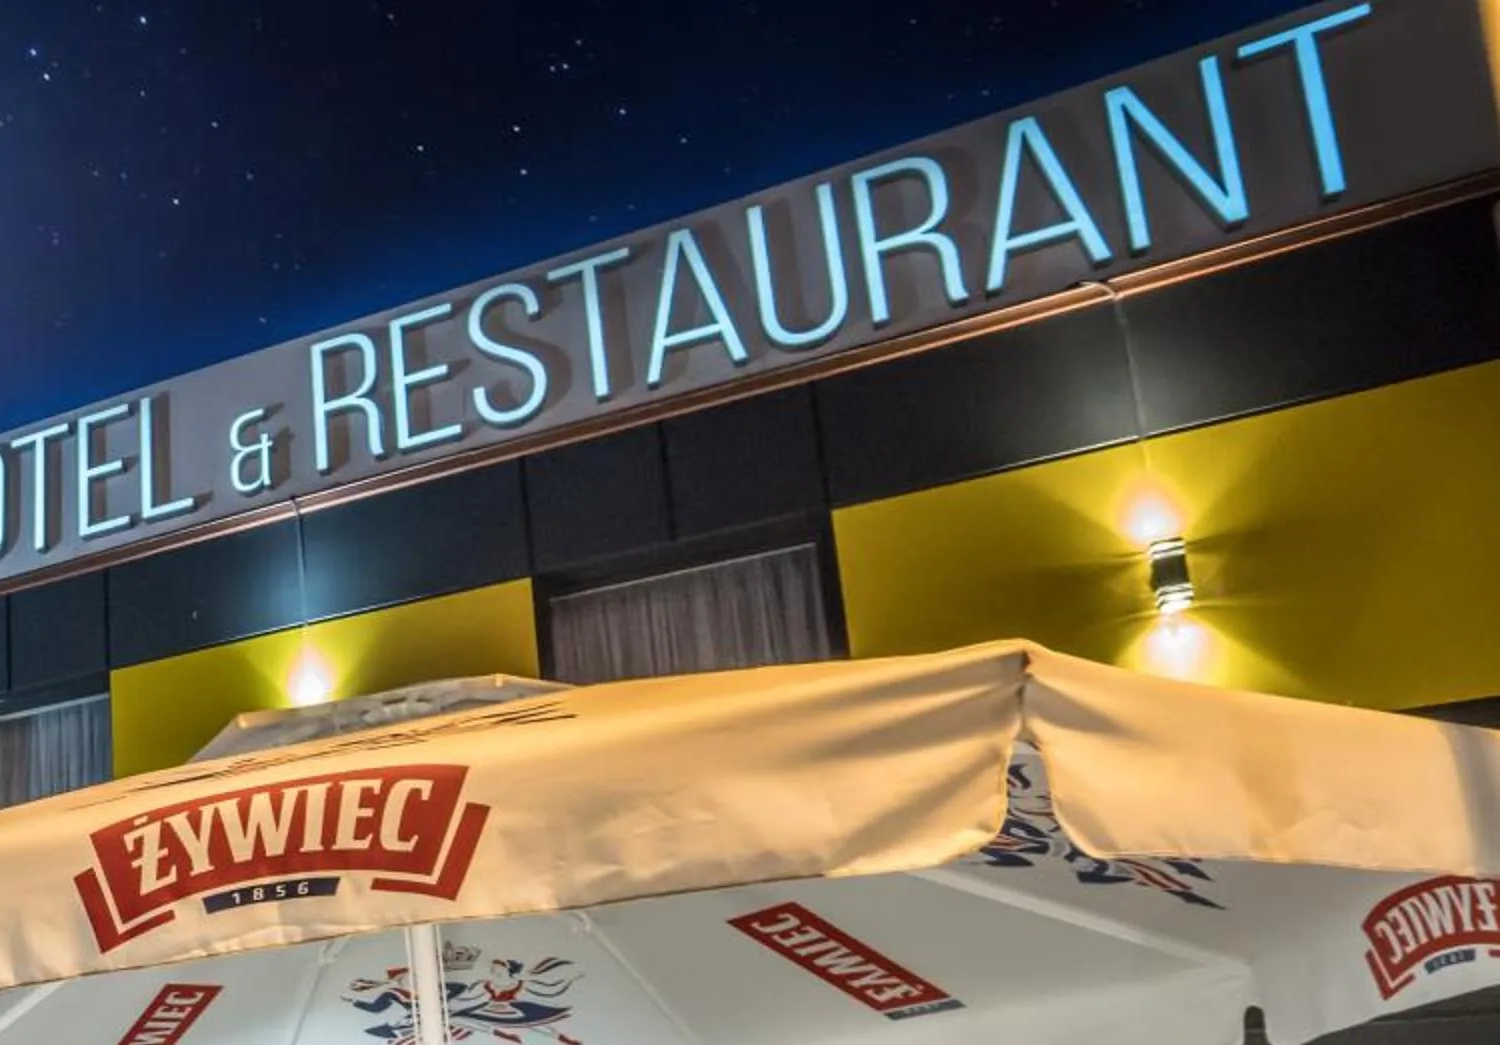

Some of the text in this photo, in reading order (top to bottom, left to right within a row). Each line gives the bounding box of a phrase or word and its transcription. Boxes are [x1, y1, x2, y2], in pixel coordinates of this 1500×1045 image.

[229, 407, 274, 493] &
[309, 3, 1371, 473] RESTAURANT
[123, 777, 435, 897] ŻYWIEC
[231, 881, 310, 905] 1856
